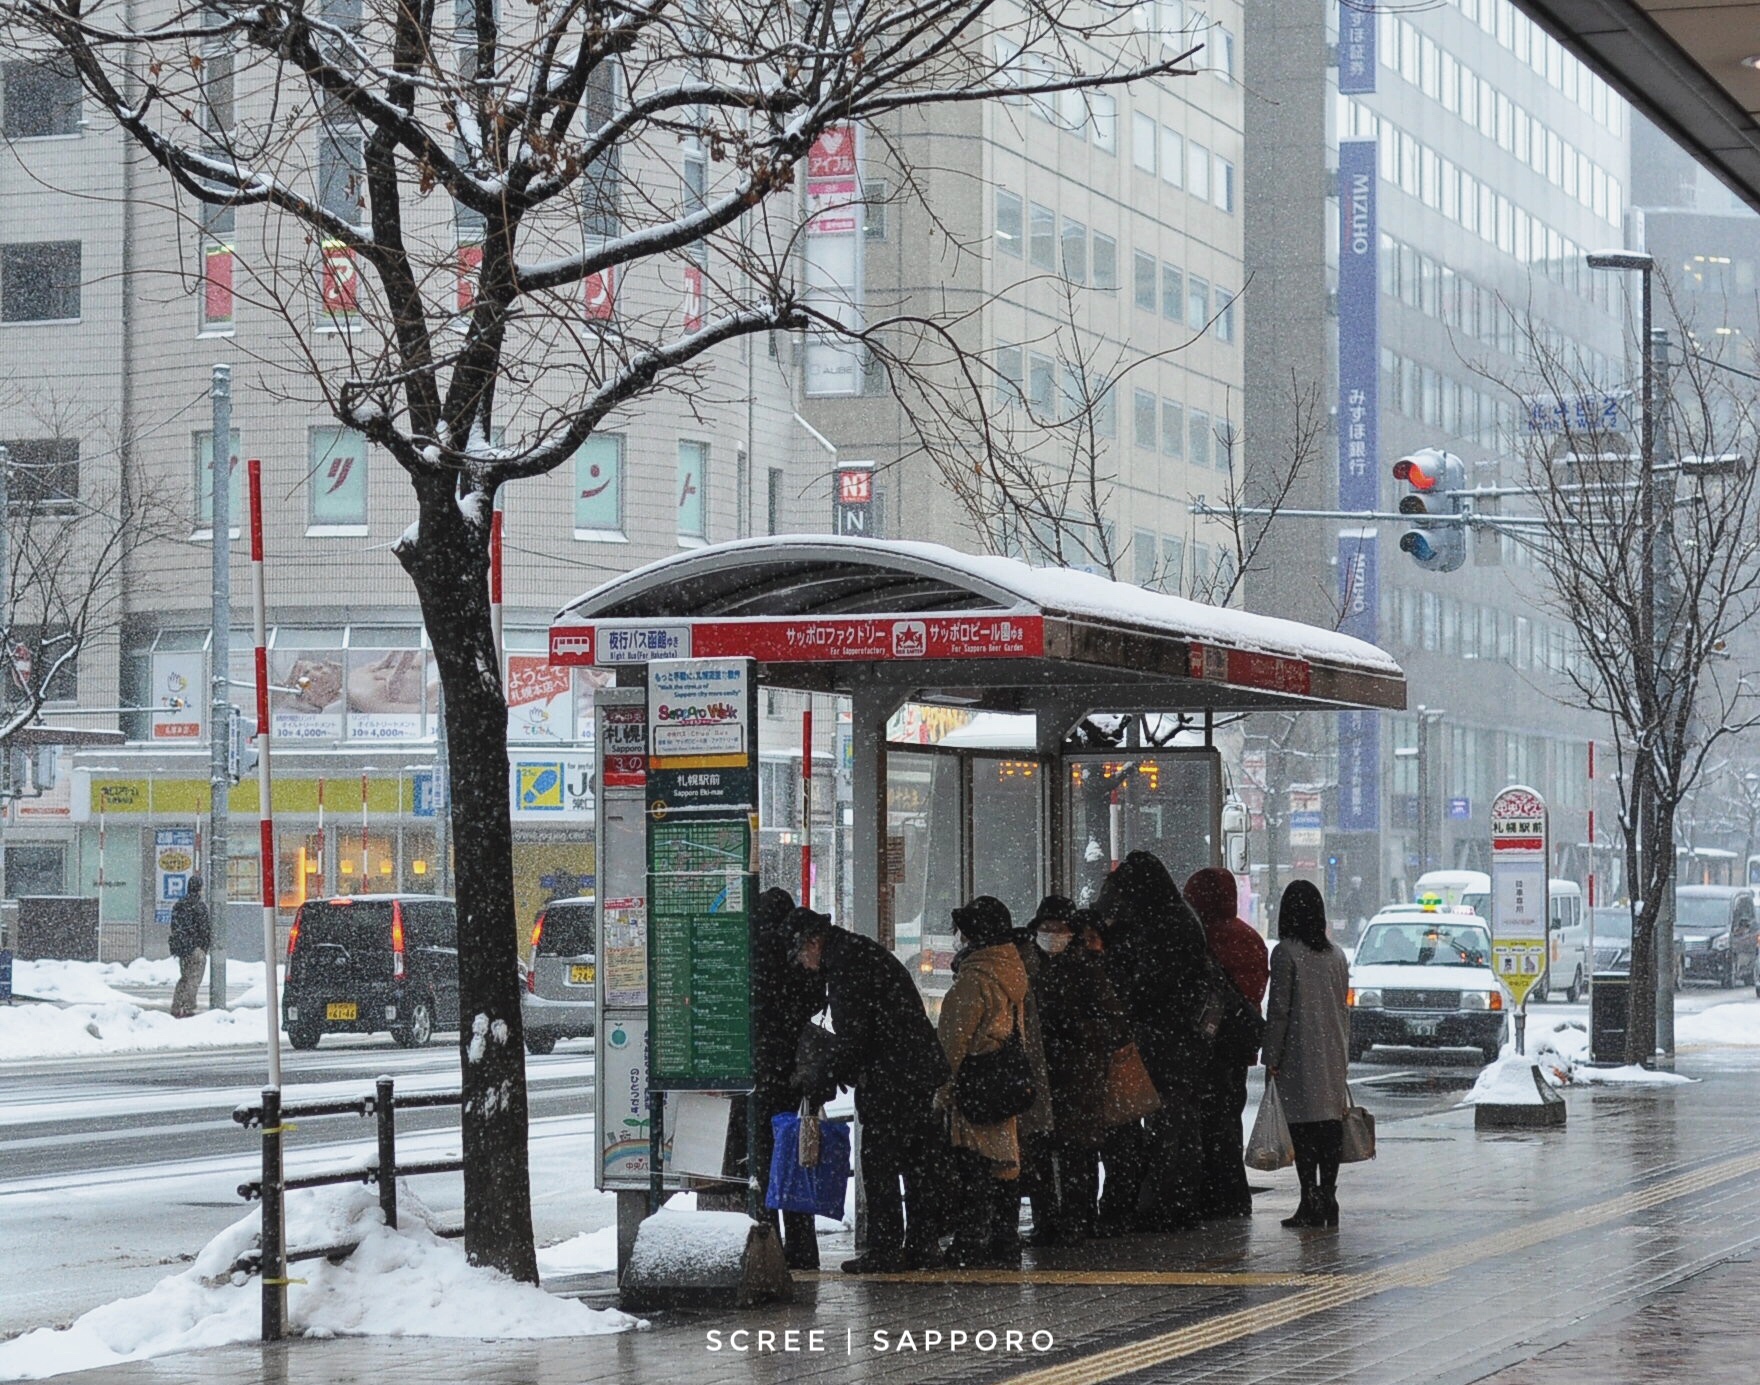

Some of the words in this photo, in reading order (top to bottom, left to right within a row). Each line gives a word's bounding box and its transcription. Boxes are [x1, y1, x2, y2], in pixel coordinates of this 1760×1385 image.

[809, 155, 853, 173] アイフル
[1352, 173, 1369, 255] MIZUHO
[1348, 388, 1367, 475] みずほ銀行
[609, 630, 680, 651] 夜行バス函館ゆき
[786, 623, 886, 646] サッポロファクトリー
[929, 620, 1024, 645] サッポロビール園ゆき
[658, 704, 707, 721] Sapporo
[611, 744, 643, 754] Sapporo
[676, 773, 721, 787] 札幌駅前
[673, 788, 699, 799] Sapporo
[1493, 820, 1543, 834] 札幌駅前
